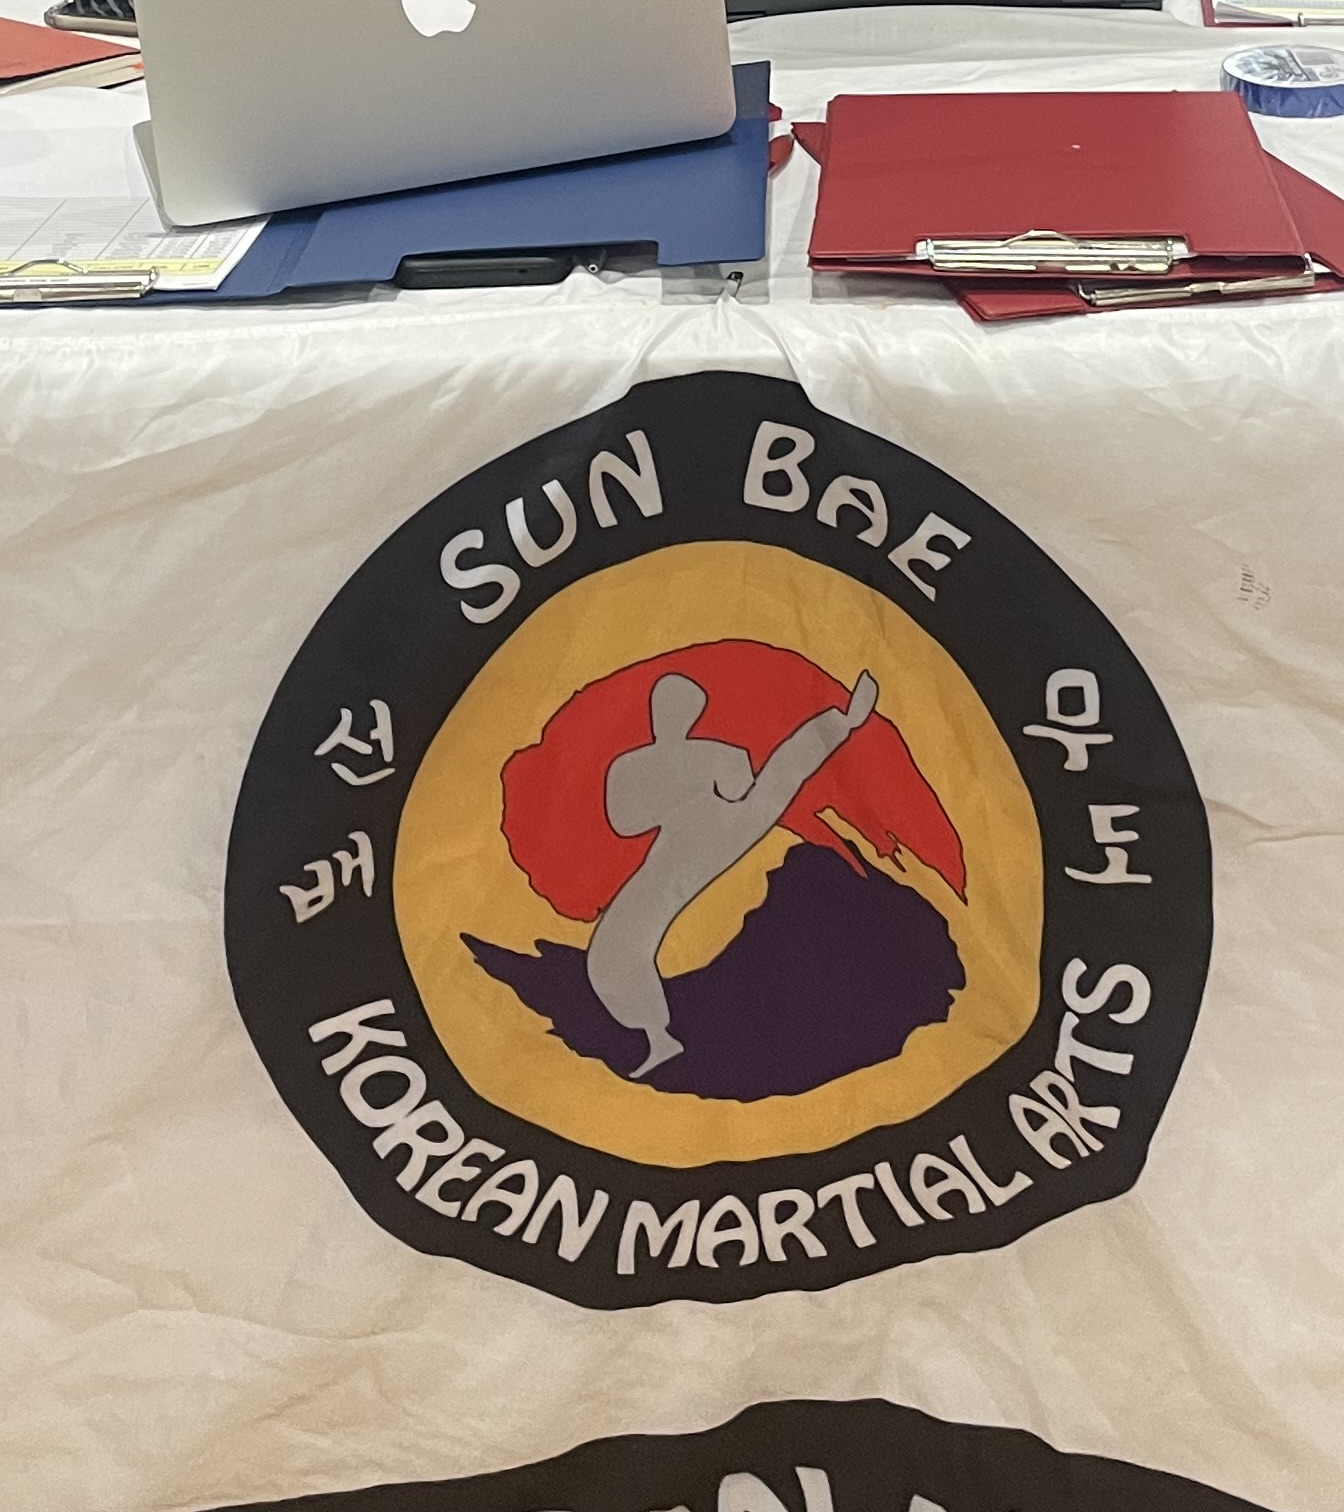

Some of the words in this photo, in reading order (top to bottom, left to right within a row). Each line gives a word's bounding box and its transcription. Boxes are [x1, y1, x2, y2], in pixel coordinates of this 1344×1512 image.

[439, 429, 663, 624] SUN
[743, 420, 972, 602] BAE
[279, 699, 396, 923] 선배
[1022, 668, 1153, 884] 무도
[309, 998, 611, 1264] KOREAN
[617, 1133, 1032, 1275] MARTIAL
[1011, 956, 1152, 1170] ARTS
